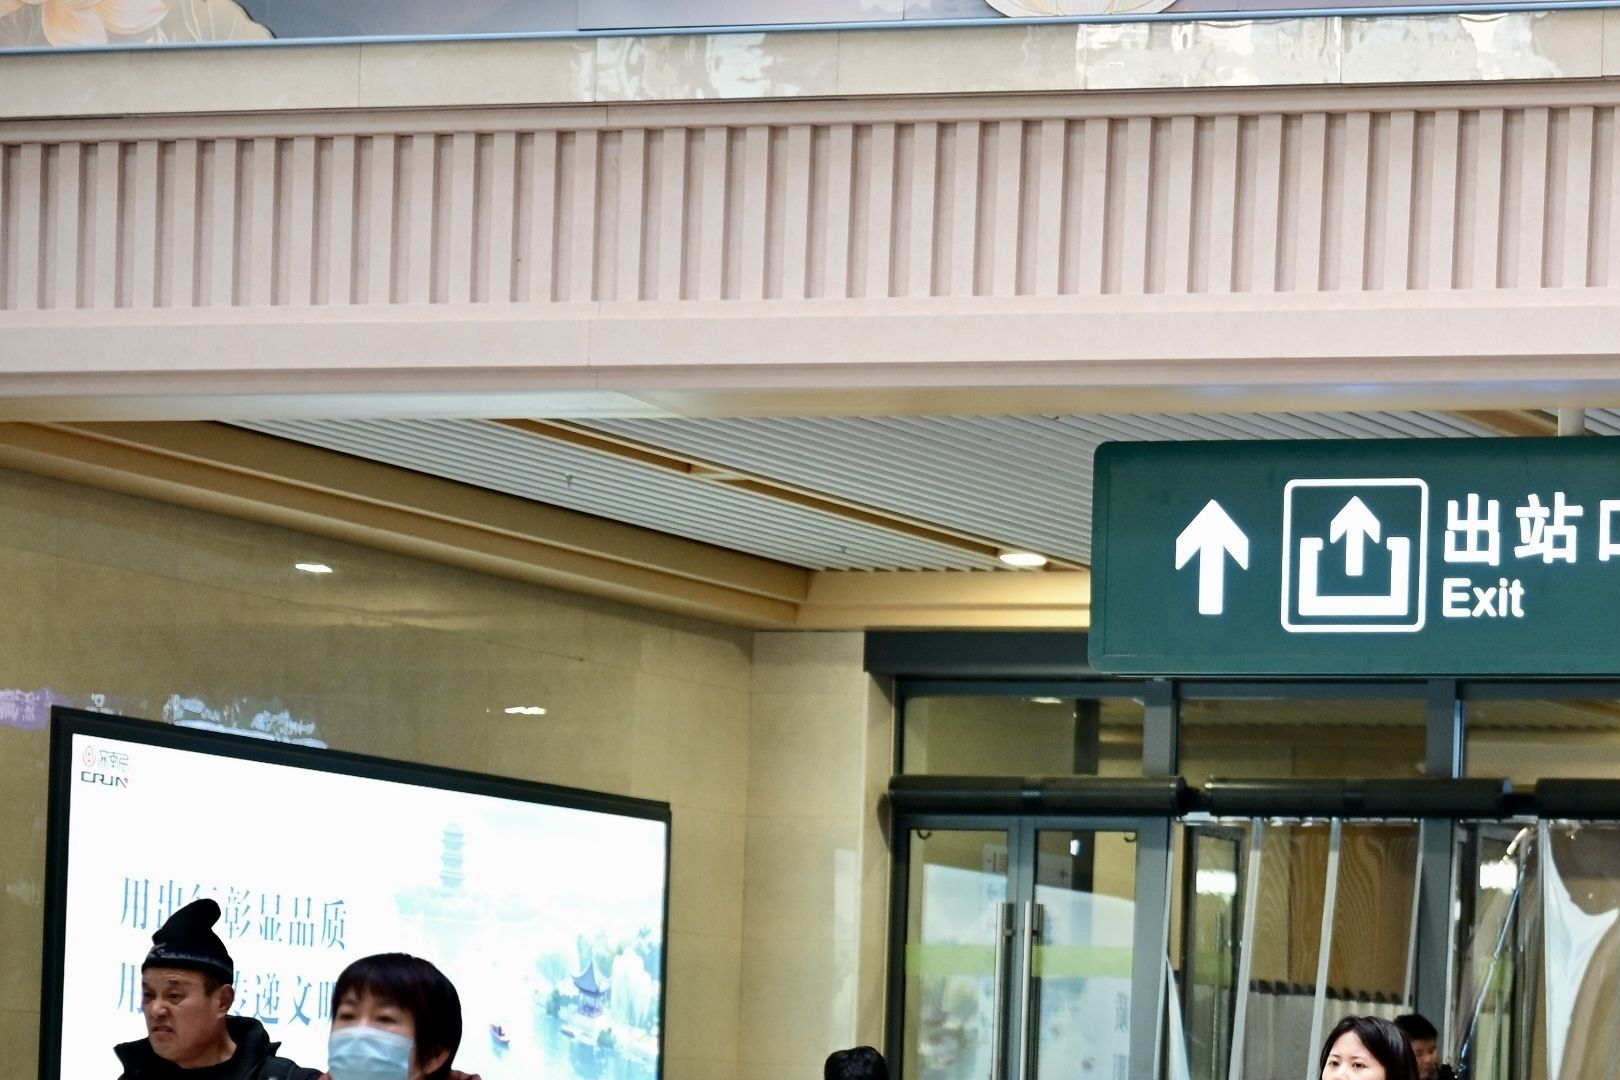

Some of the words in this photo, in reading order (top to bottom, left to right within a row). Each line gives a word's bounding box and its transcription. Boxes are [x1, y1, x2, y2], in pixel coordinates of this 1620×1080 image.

[1442, 577, 1525, 618] Exit
[120, 877, 347, 950] 用出彰显品质
[117, 961, 336, 1026] 用递文明
